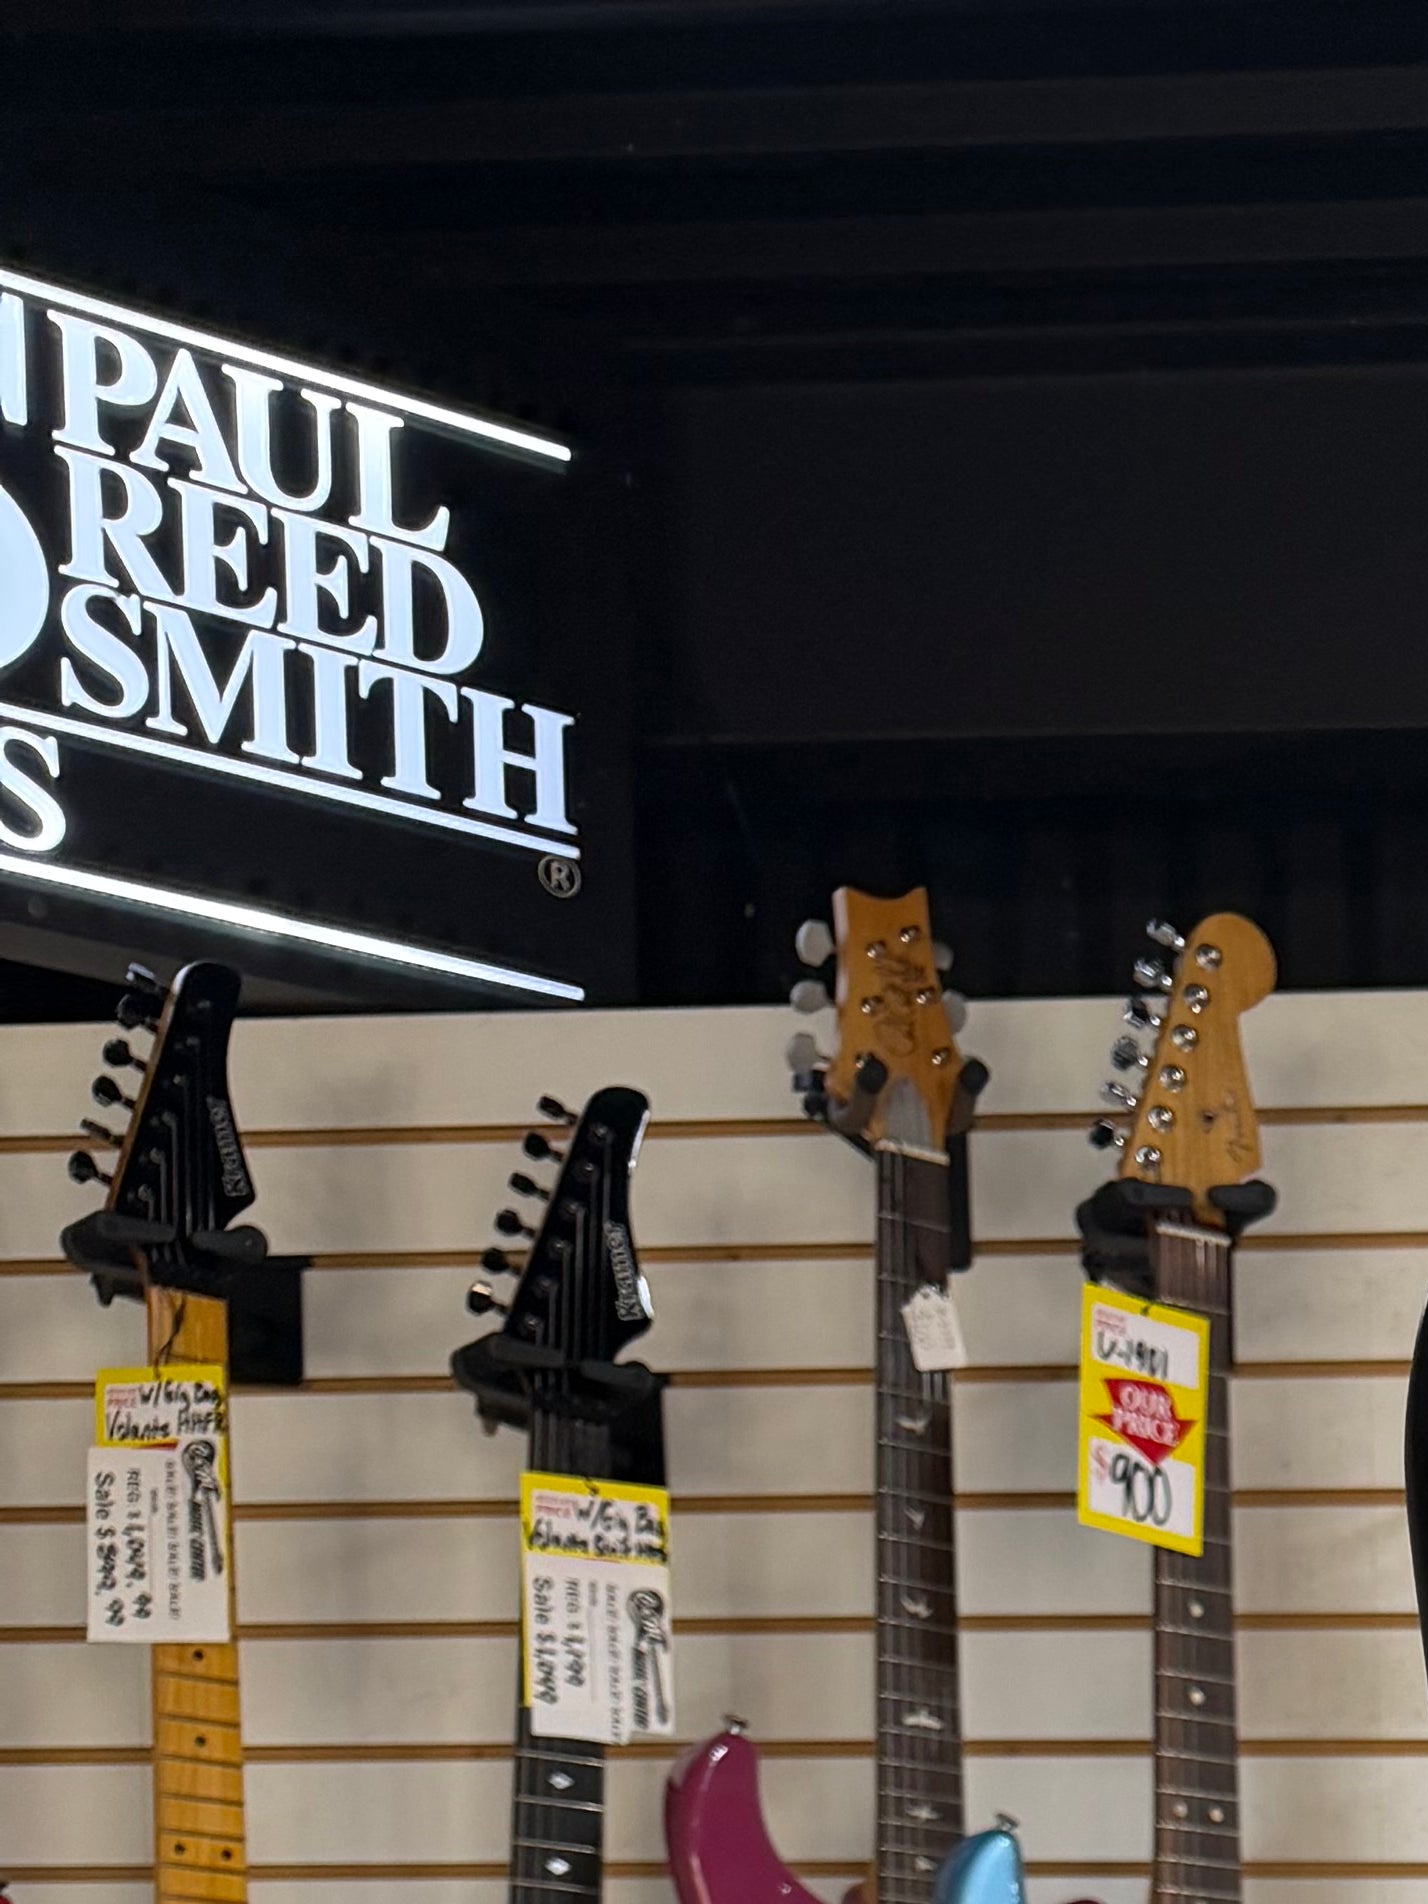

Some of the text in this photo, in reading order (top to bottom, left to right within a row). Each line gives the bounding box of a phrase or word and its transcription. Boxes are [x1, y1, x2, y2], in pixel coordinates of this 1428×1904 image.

[46, 308, 450, 552] PAUL
[54, 445, 486, 677] REED
[59, 582, 580, 836] SMITH
[603, 1219, 645, 1323] Kramer
[1119, 1382, 1173, 1418] OUR
[94, 1471, 116, 1521] Sale
[533, 1576, 555, 1626] Sale
